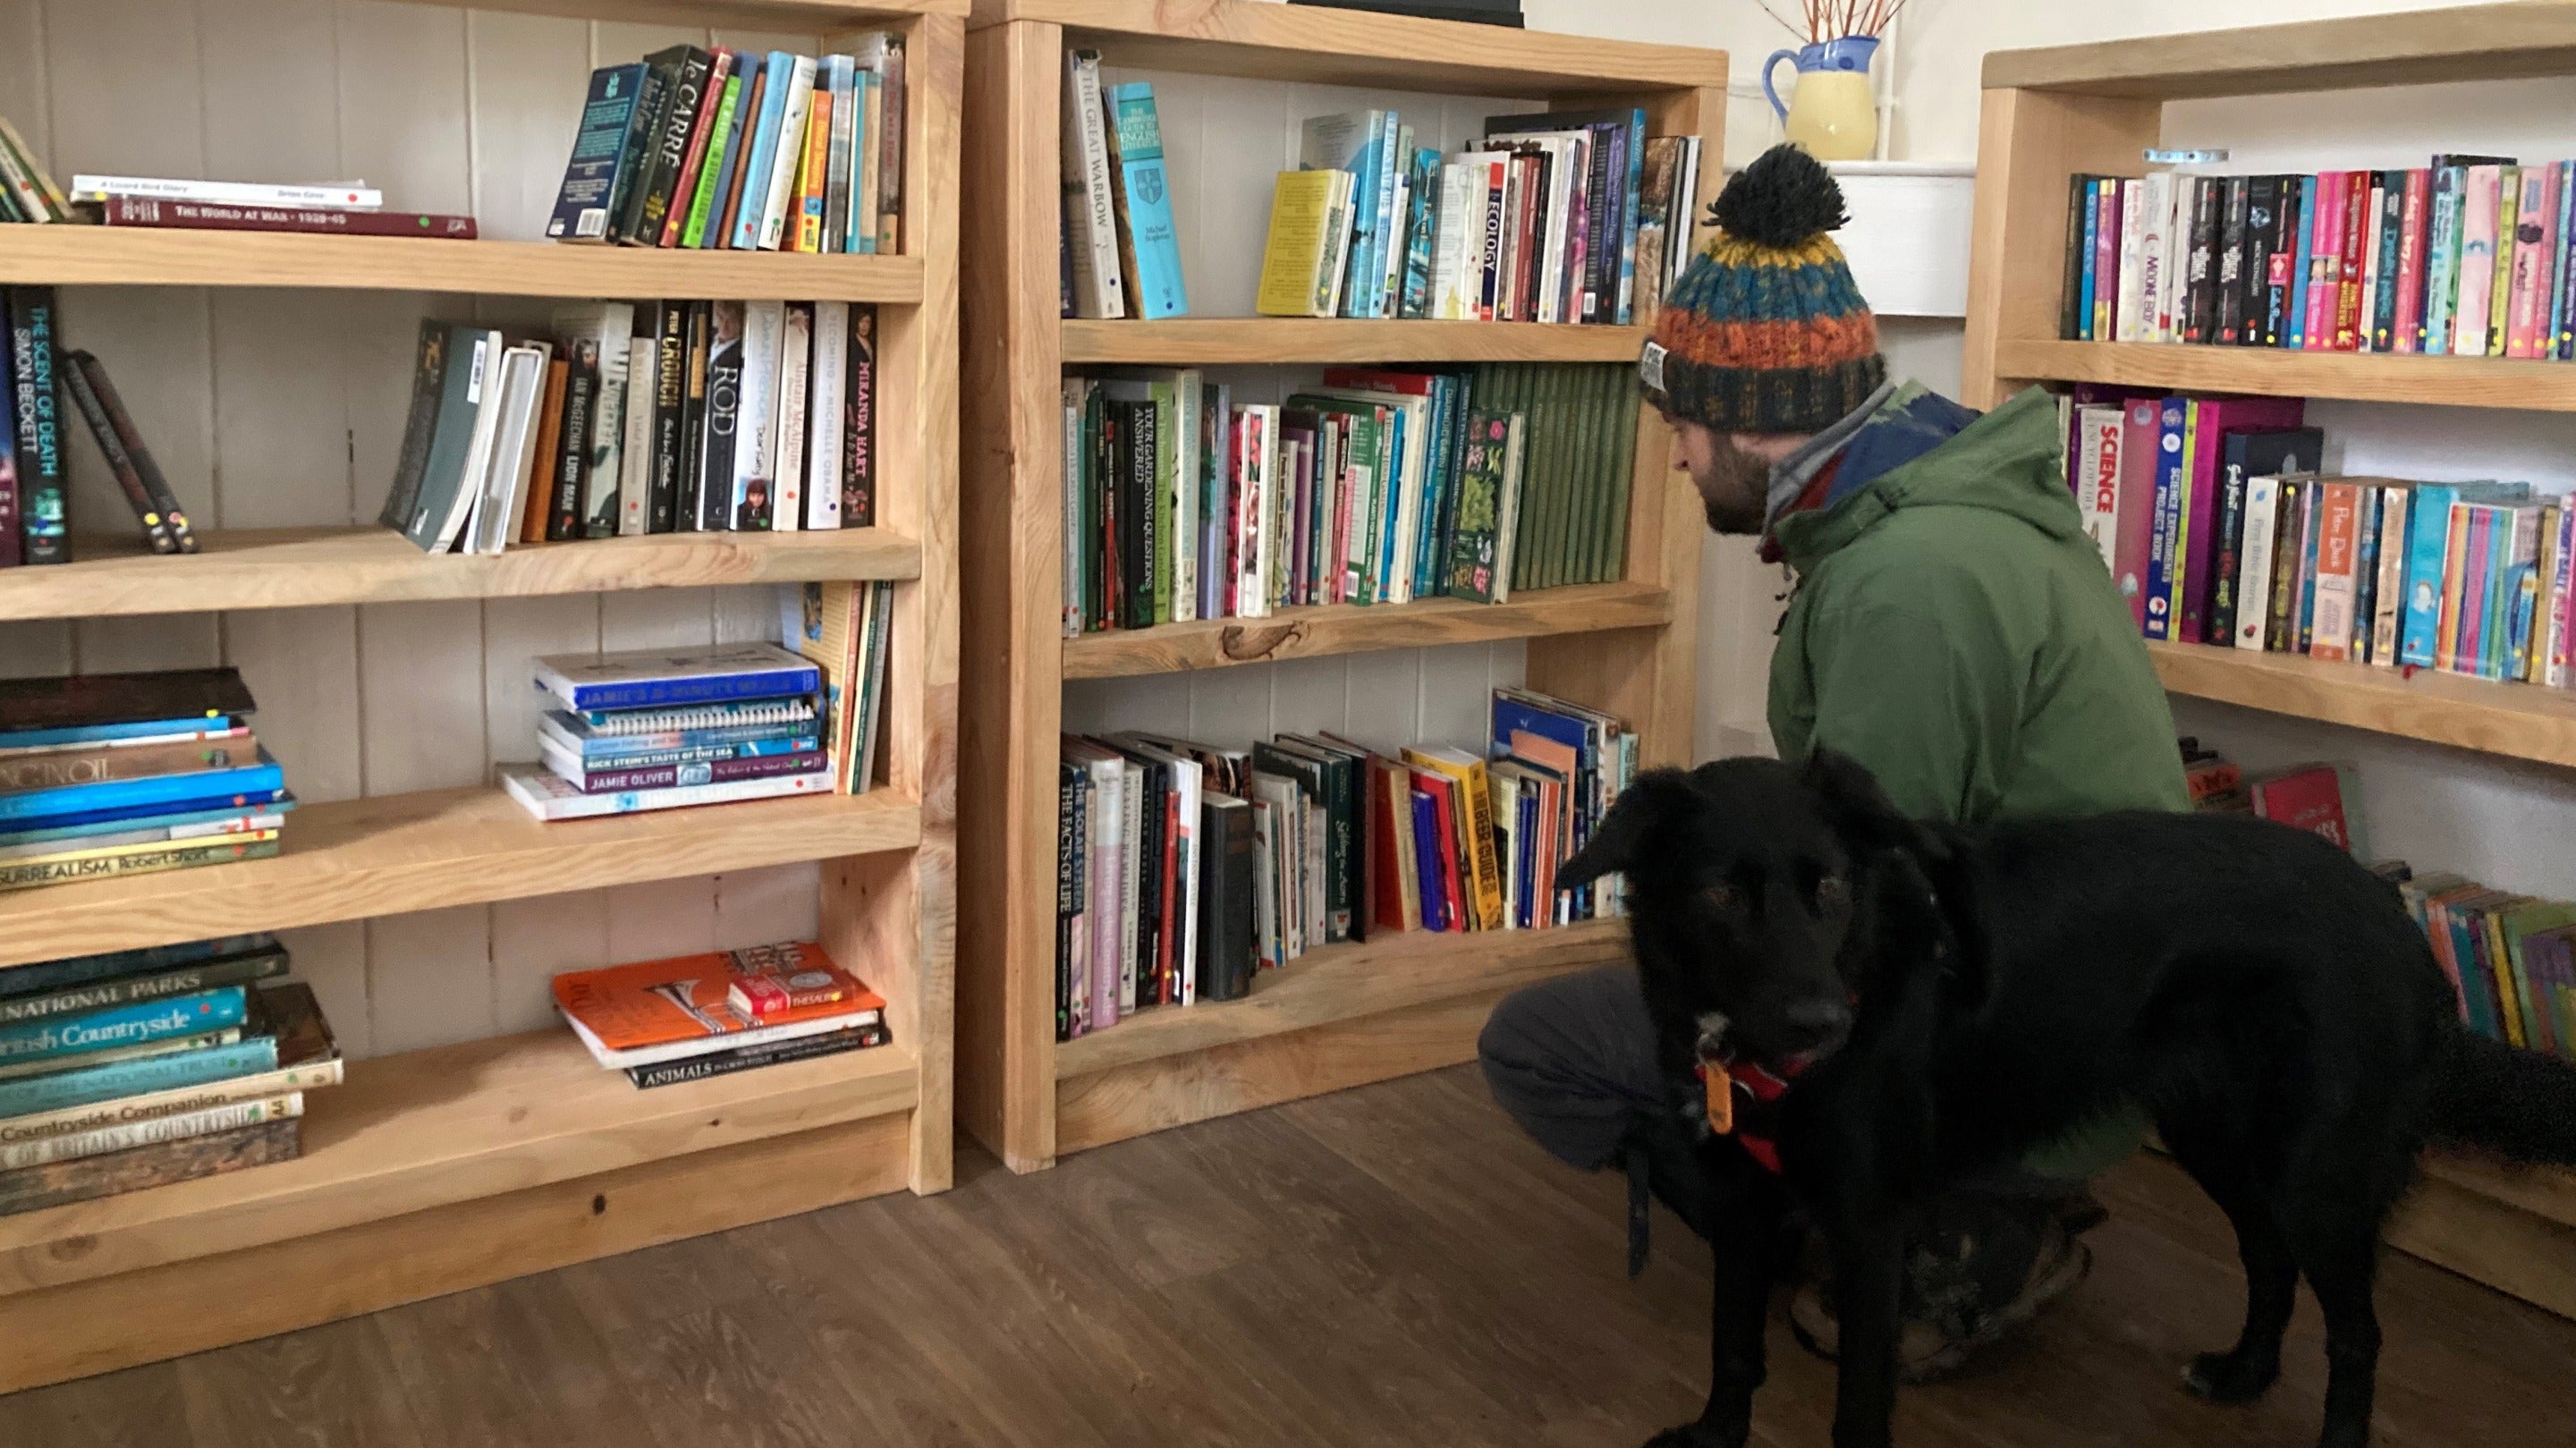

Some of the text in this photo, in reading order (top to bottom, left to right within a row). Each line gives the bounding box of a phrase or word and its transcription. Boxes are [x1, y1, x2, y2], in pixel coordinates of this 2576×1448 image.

[686, 58, 707, 79] le
[1082, 76, 1096, 106] THE
[659, 83, 699, 168] CARRÉ
[1085, 108, 1100, 154] GREAT
[1121, 130, 1160, 141] ENGLISH
[1090, 158, 1108, 229] WARBOW
[1484, 201, 1500, 271] ECOLOGY
[2143, 300, 2157, 325] BOY
[659, 310, 682, 409] PETER CROUCH
[14, 327, 38, 453] SIMON BECKETT
[30, 308, 57, 477] THE SCENT OF DEATH
[574, 377, 589, 393] IAN
[712, 365, 739, 436] ROD
[822, 314, 837, 504] BECOMING MICHELLE OBAMA
[755, 424, 767, 450] Dear
[790, 360, 807, 470] Alistair McAlpine
[854, 361, 870, 478] MIRANDA HART
[1437, 388, 1453, 468] DIARMUID GAVIN
[1134, 407, 1145, 484] ANSWERED
[2097, 425, 2119, 514] SCIENCE
[1143, 407, 1154, 589] YOUR GARDENING QUESTIONS
[2332, 501, 2350, 529] Peter
[1157, 504, 1166, 545] Kitchen
[2151, 486, 2167, 562] PROJECT BOOK
[2161, 467, 2181, 583] SCIENCE EXPERIMENTS
[1156, 546, 1166, 594] Gardene
[587, 747, 733, 770] RICK STEIN'S TASTE OF THE SEA
[590, 772, 674, 789] JAMIE OLIVER
[1061, 784, 1072, 816] THE
[1061, 816, 1072, 859] FACTS
[1073, 781, 1085, 910] THE SOLAR SYSTEM
[1474, 809, 1496, 885] BEER GUIDE
[0, 859, 112, 884] SURREALISM
[119, 851, 170, 870] Robert
[1061, 863, 1072, 882] OF
[1099, 855, 1116, 899] Living
[1060, 883, 1072, 912] LIFE
[4, 972, 202, 1020] NATIONAL PARKS
[62, 1007, 191, 1047] Countryside
[644, 1062, 714, 1088] ANIMALS
[1, 1092, 226, 1141] Countryside Companion
